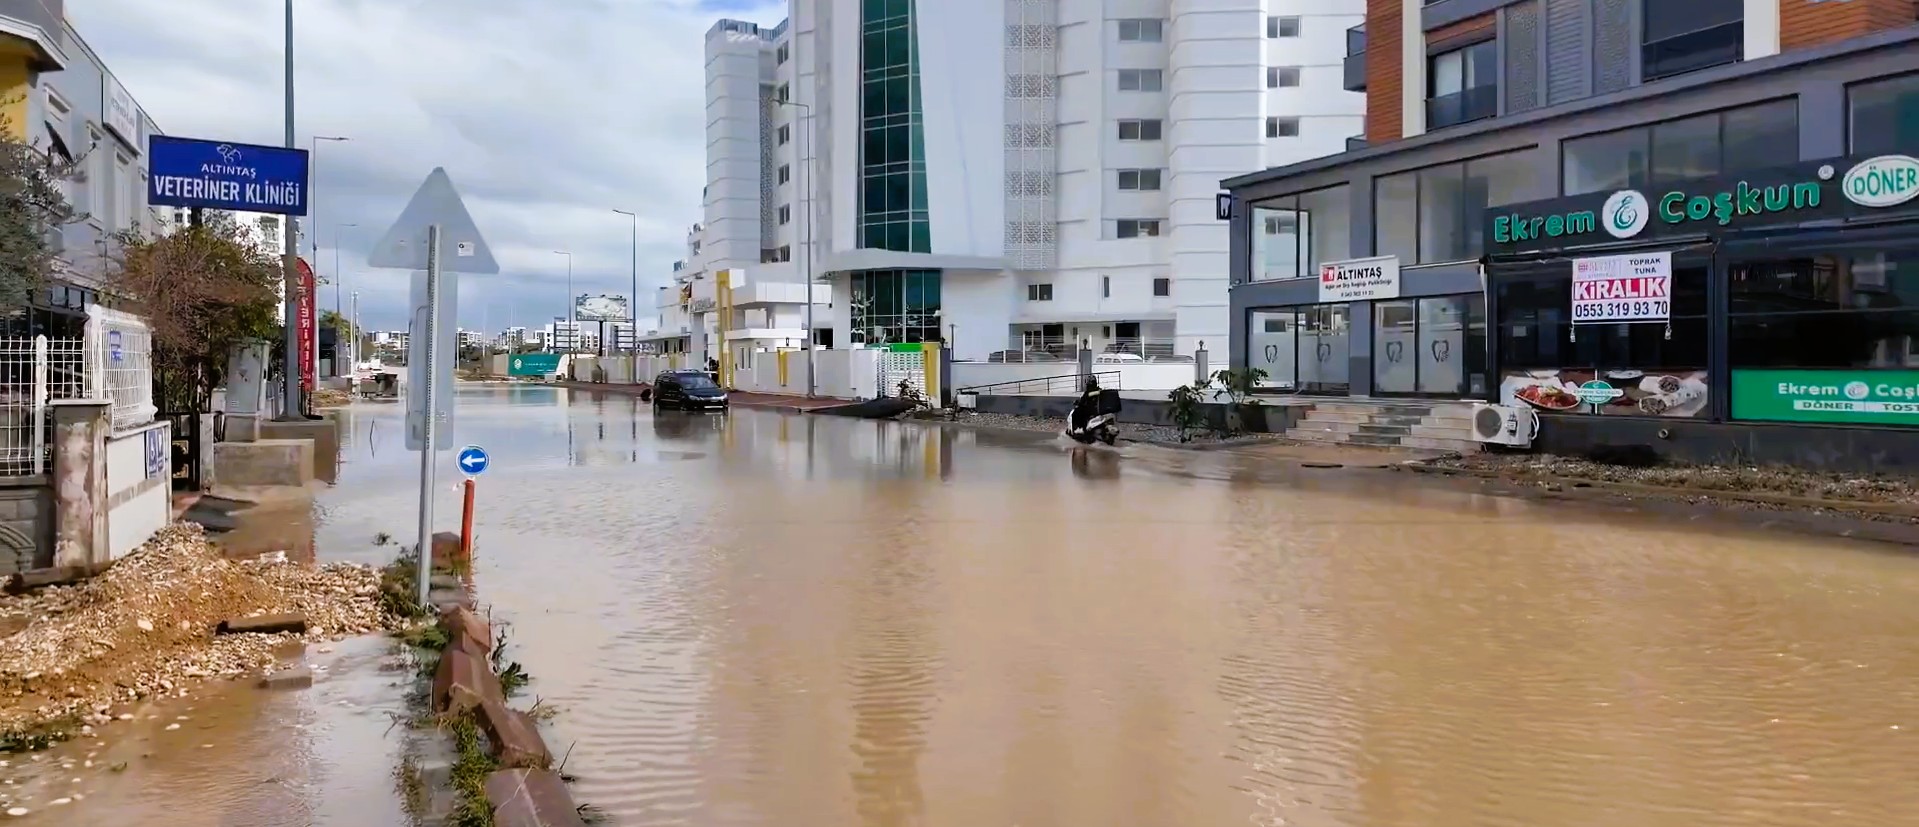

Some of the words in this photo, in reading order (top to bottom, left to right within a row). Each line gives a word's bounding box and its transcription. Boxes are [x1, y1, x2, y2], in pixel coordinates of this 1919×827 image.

[201, 163, 257, 179] ALTINTAŞ
[1853, 165, 1918, 196] DÖNER
[154, 174, 240, 202] VETERİNER
[245, 179, 300, 206] KLİNİĞİ
[1494, 210, 1595, 243] Ekrem
[1659, 180, 1820, 225] Coşkun
[1337, 266, 1382, 280] ALTINTAŞ
[1634, 267, 1657, 275] TUNA
[1575, 303, 1603, 317] 0553
[1607, 302, 1630, 316] 319
[1634, 301, 1649, 315] 93
[1654, 301, 1668, 315] 70
[1778, 382, 1839, 396] Ekrem
[1803, 401, 1854, 410] DÖNER
